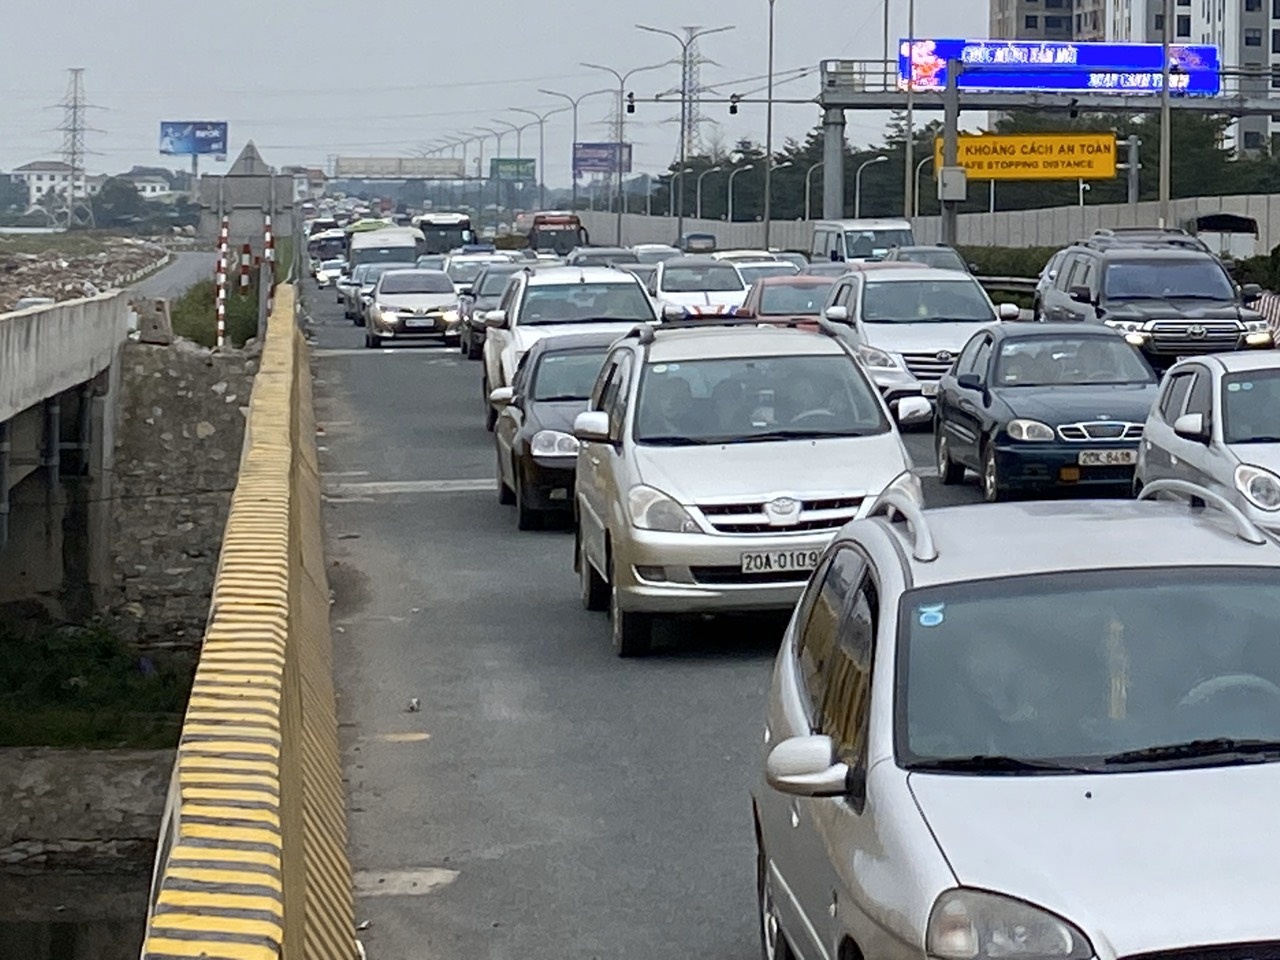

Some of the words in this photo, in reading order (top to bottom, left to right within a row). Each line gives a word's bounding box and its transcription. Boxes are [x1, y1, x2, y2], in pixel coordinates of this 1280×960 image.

[1057, 144, 1076, 155] AN
[1079, 141, 1112, 154] TOÀN
[987, 160, 1040, 170] STOPPING
[1043, 159, 1095, 169] DISTANCE
